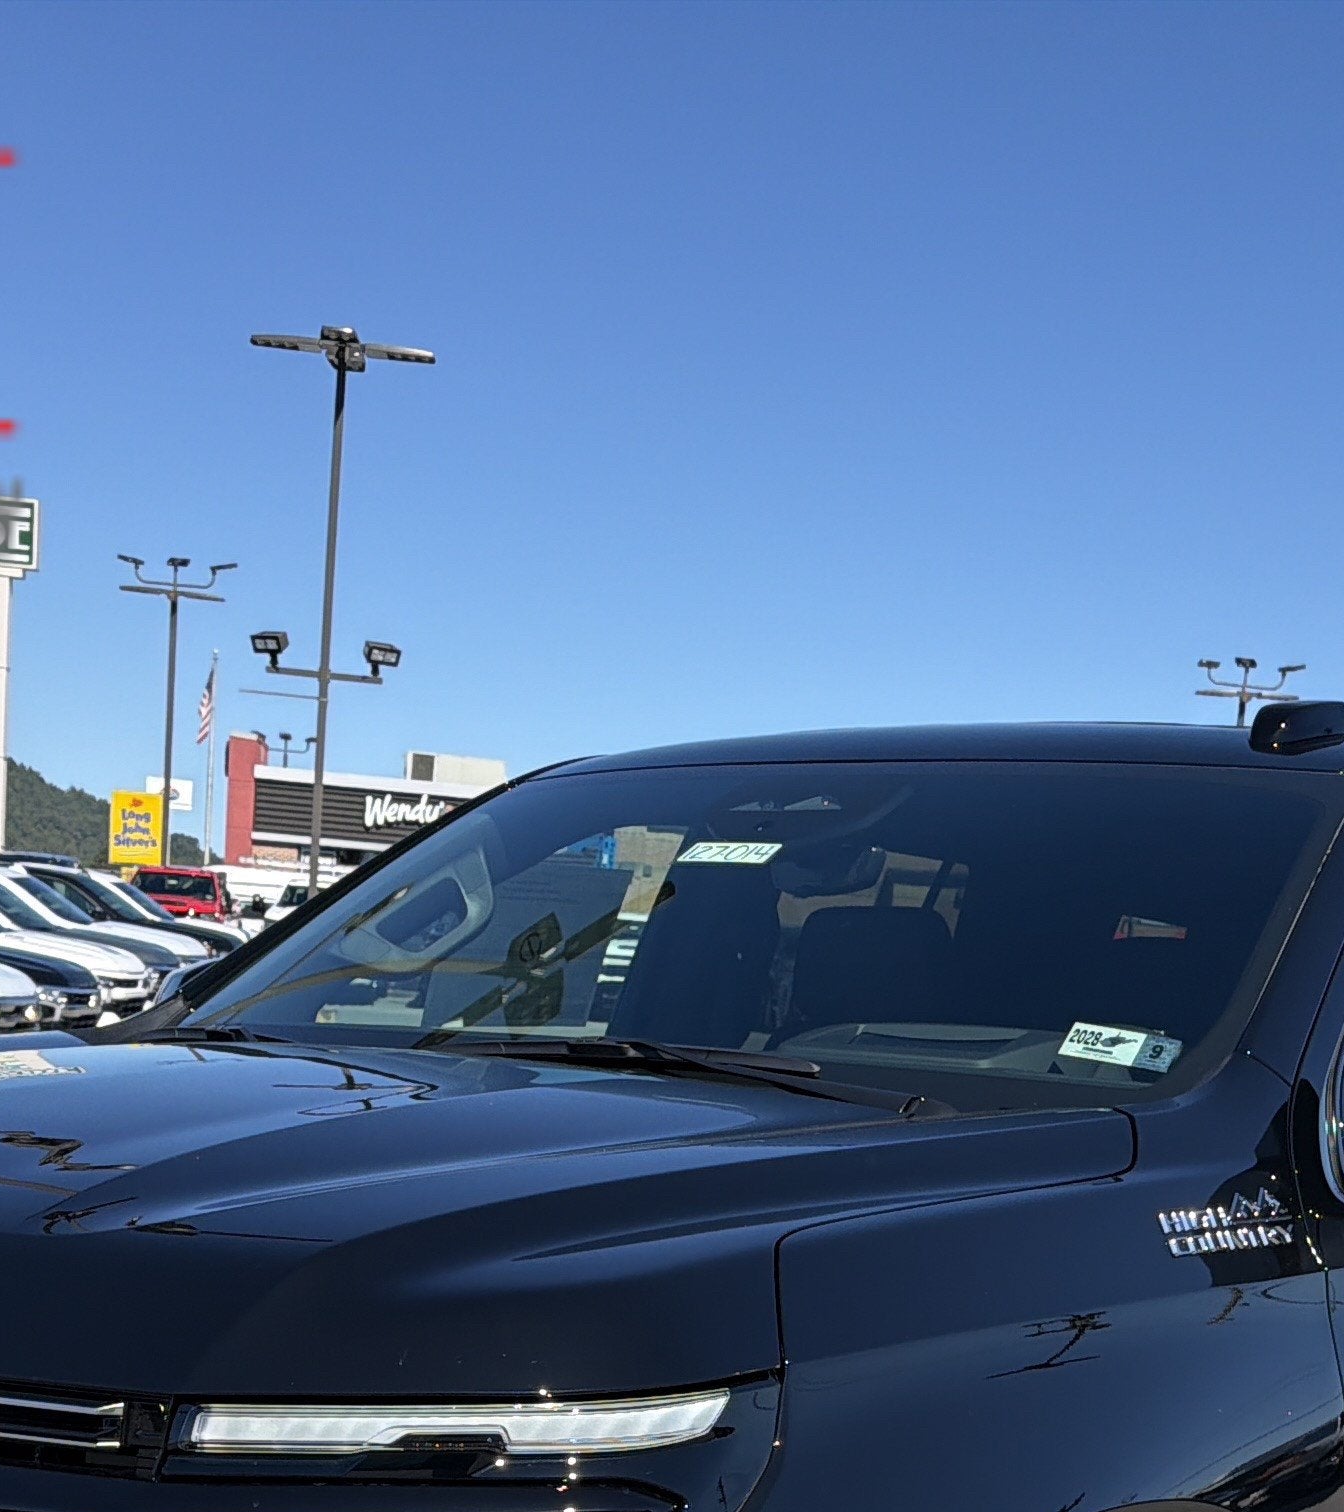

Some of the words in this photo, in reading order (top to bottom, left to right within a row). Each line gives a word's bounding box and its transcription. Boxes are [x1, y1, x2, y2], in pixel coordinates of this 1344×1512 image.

[121, 808, 152, 823] Long
[121, 821, 151, 835] John
[1068, 1028, 1103, 1047] 2028
[1149, 1044, 1165, 1060] 9
